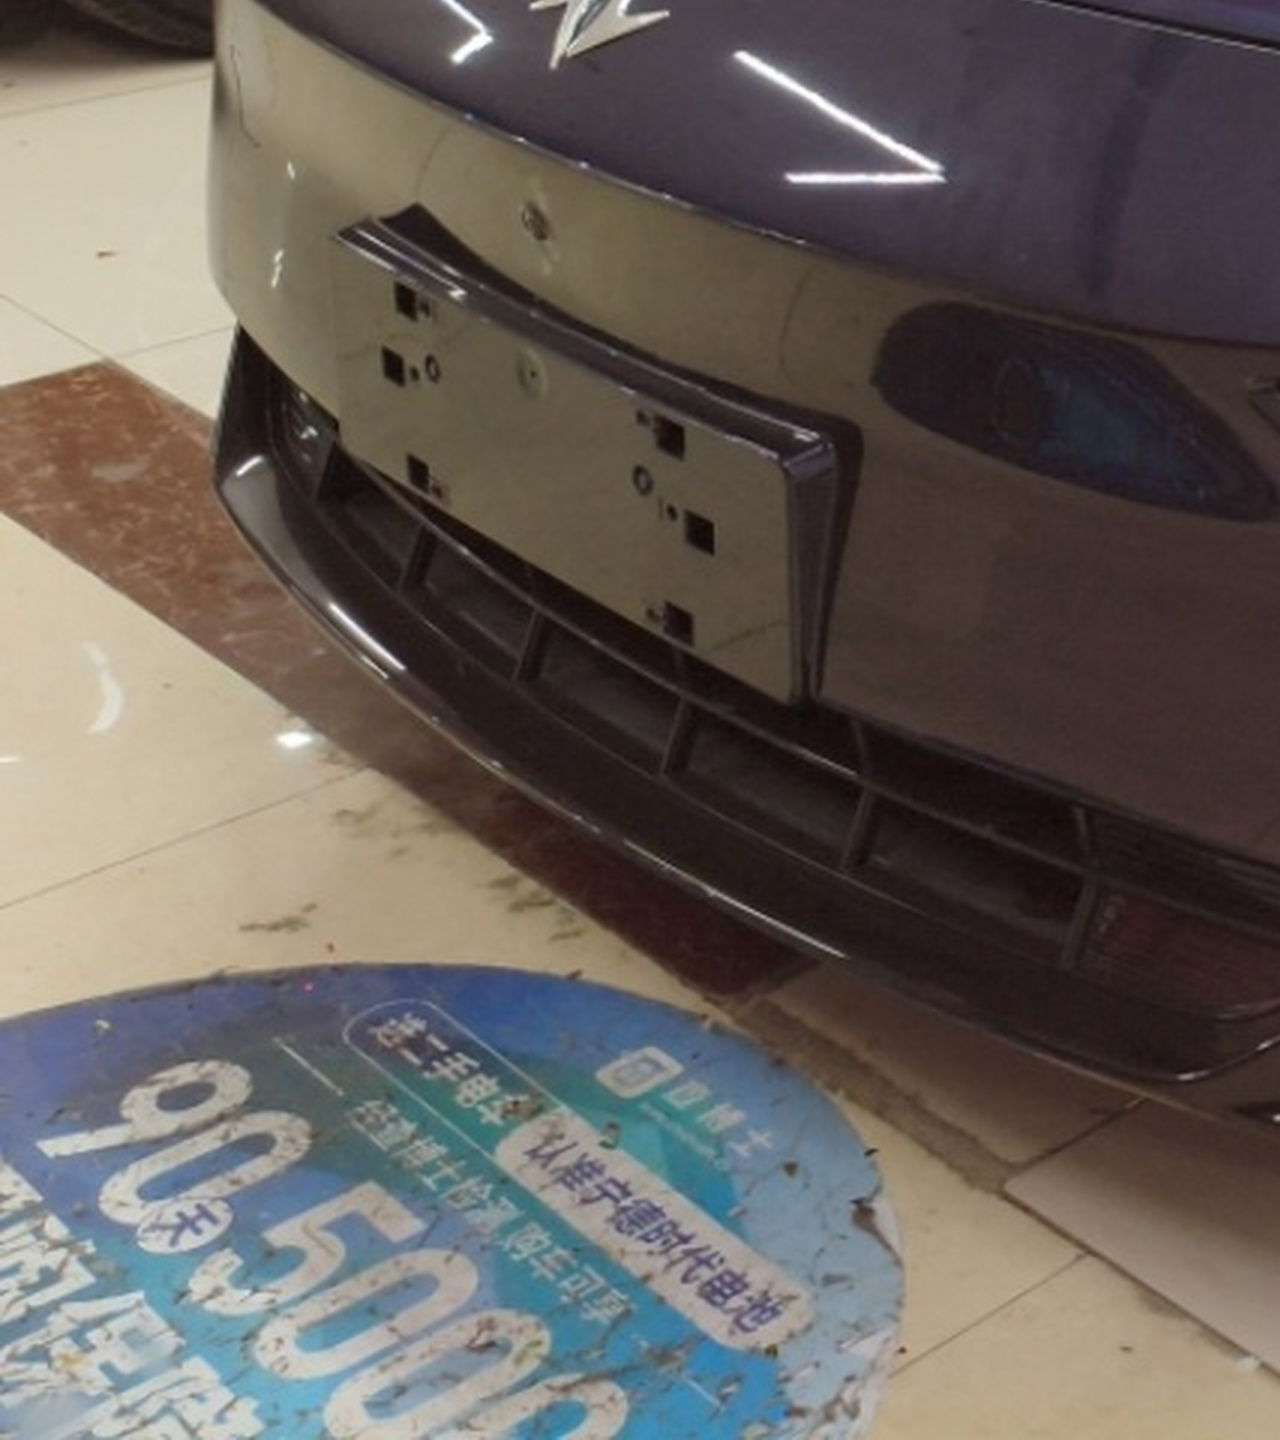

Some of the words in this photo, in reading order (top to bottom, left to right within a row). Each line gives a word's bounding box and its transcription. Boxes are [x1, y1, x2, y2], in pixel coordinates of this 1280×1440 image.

[521, 1129, 784, 1334] 认准宁德时代电池
